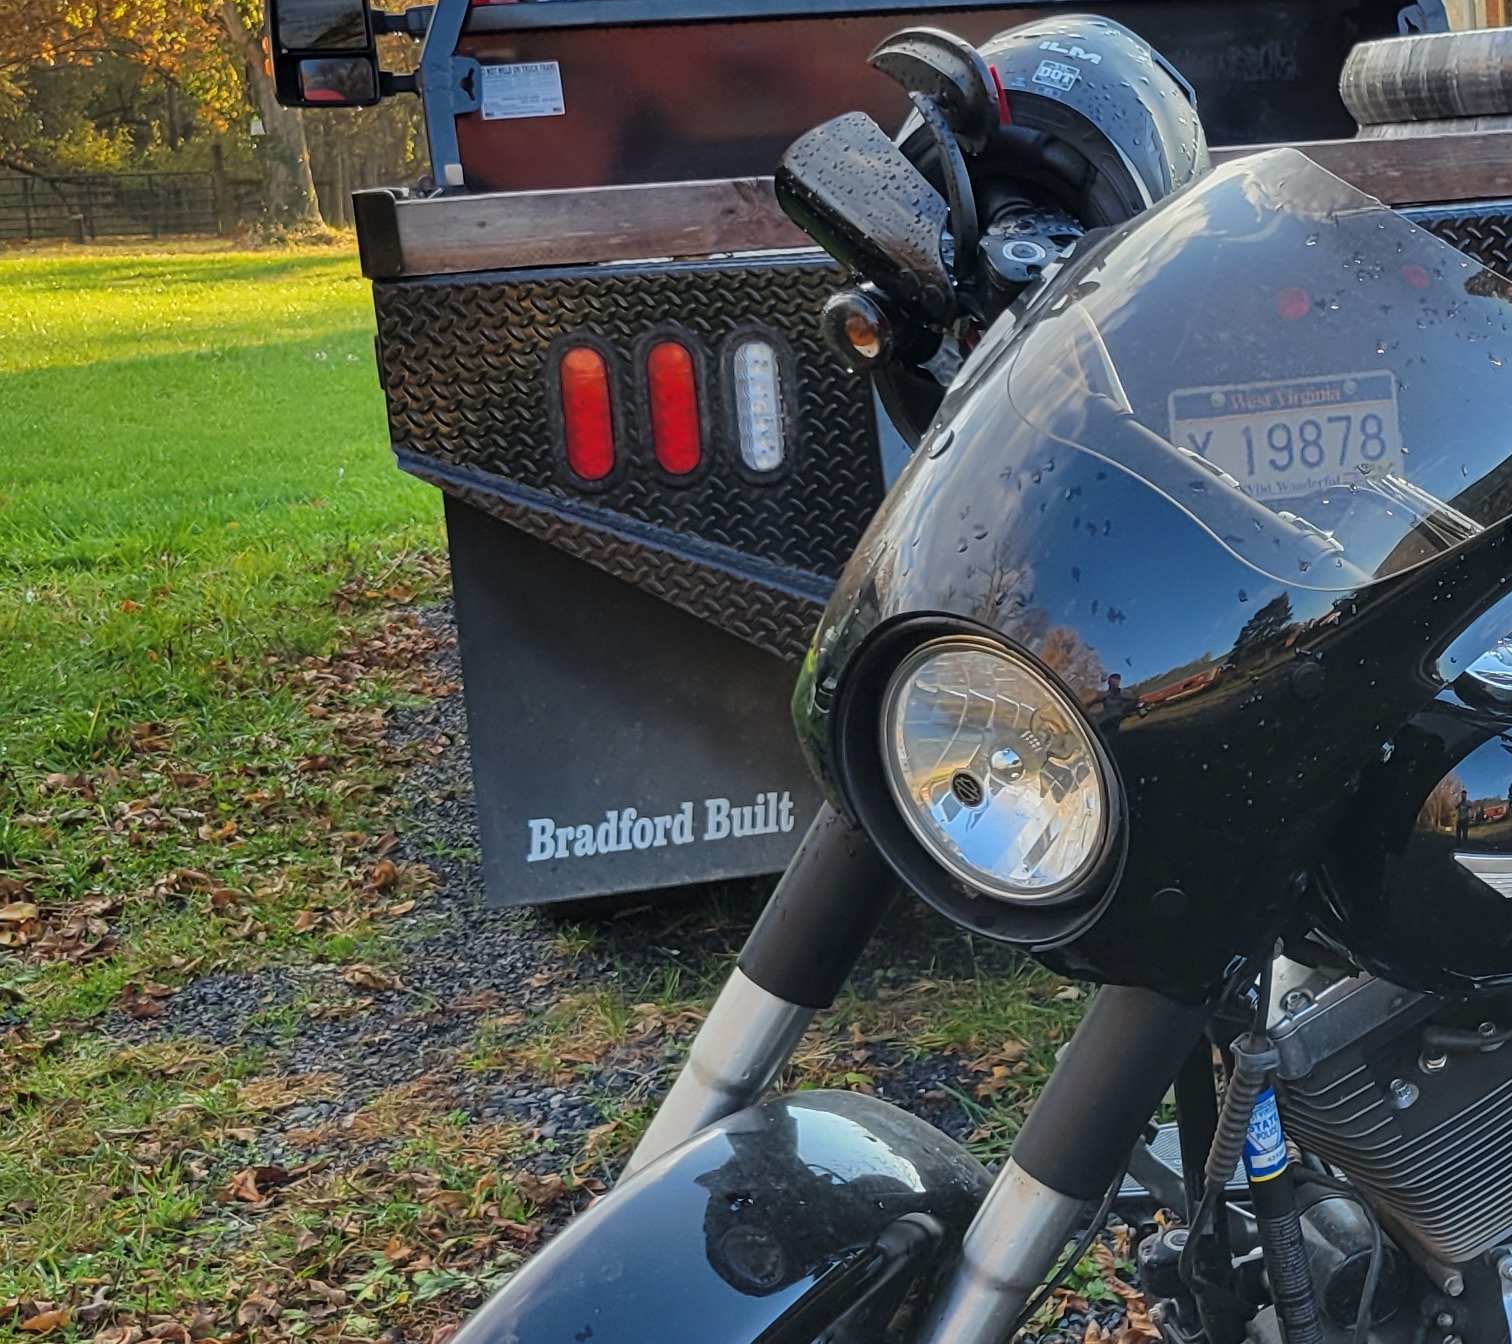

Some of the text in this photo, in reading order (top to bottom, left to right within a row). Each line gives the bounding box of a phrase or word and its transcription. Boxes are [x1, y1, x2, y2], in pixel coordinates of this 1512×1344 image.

[1039, 40, 1102, 65] ILM
[1038, 65, 1076, 85] DOT
[1230, 385, 1341, 410] West Virginia
[1242, 413, 1387, 476] 19878
[527, 791, 795, 862] Bradford Built
[1248, 1111, 1278, 1133] STATE
